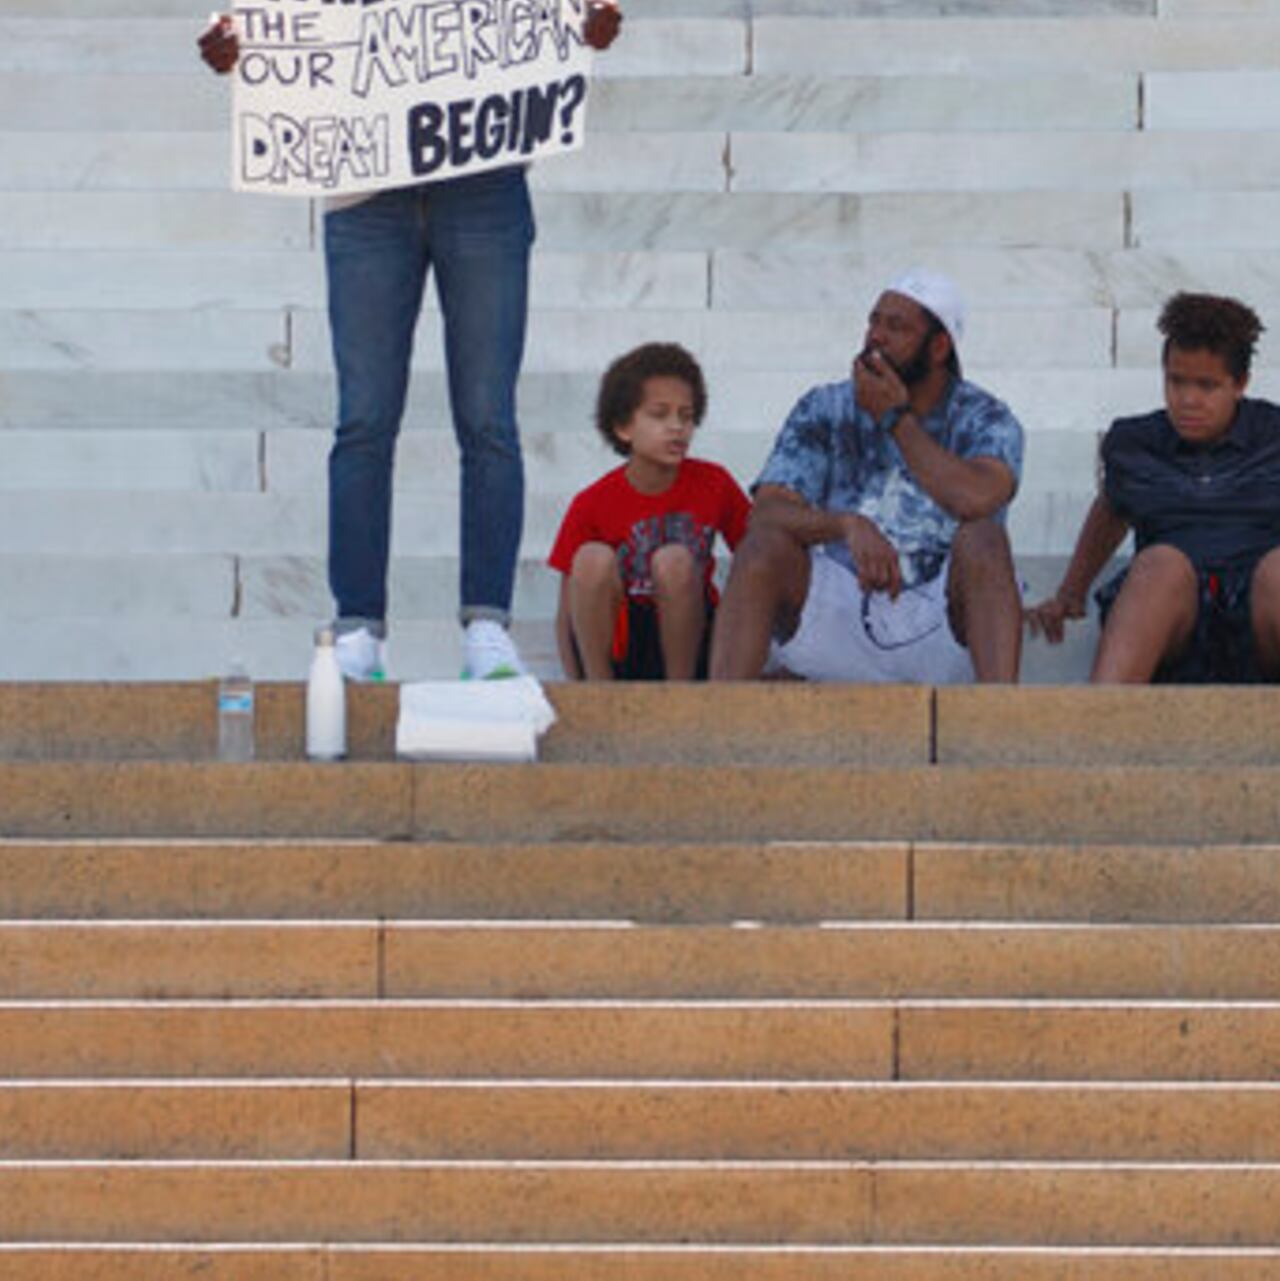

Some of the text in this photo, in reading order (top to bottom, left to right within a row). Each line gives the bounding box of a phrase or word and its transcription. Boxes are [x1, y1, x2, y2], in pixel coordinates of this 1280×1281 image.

[236, 7, 324, 44] THE
[238, 52, 335, 89] OUR
[240, 74, 587, 188] DREAM BEGIN?
